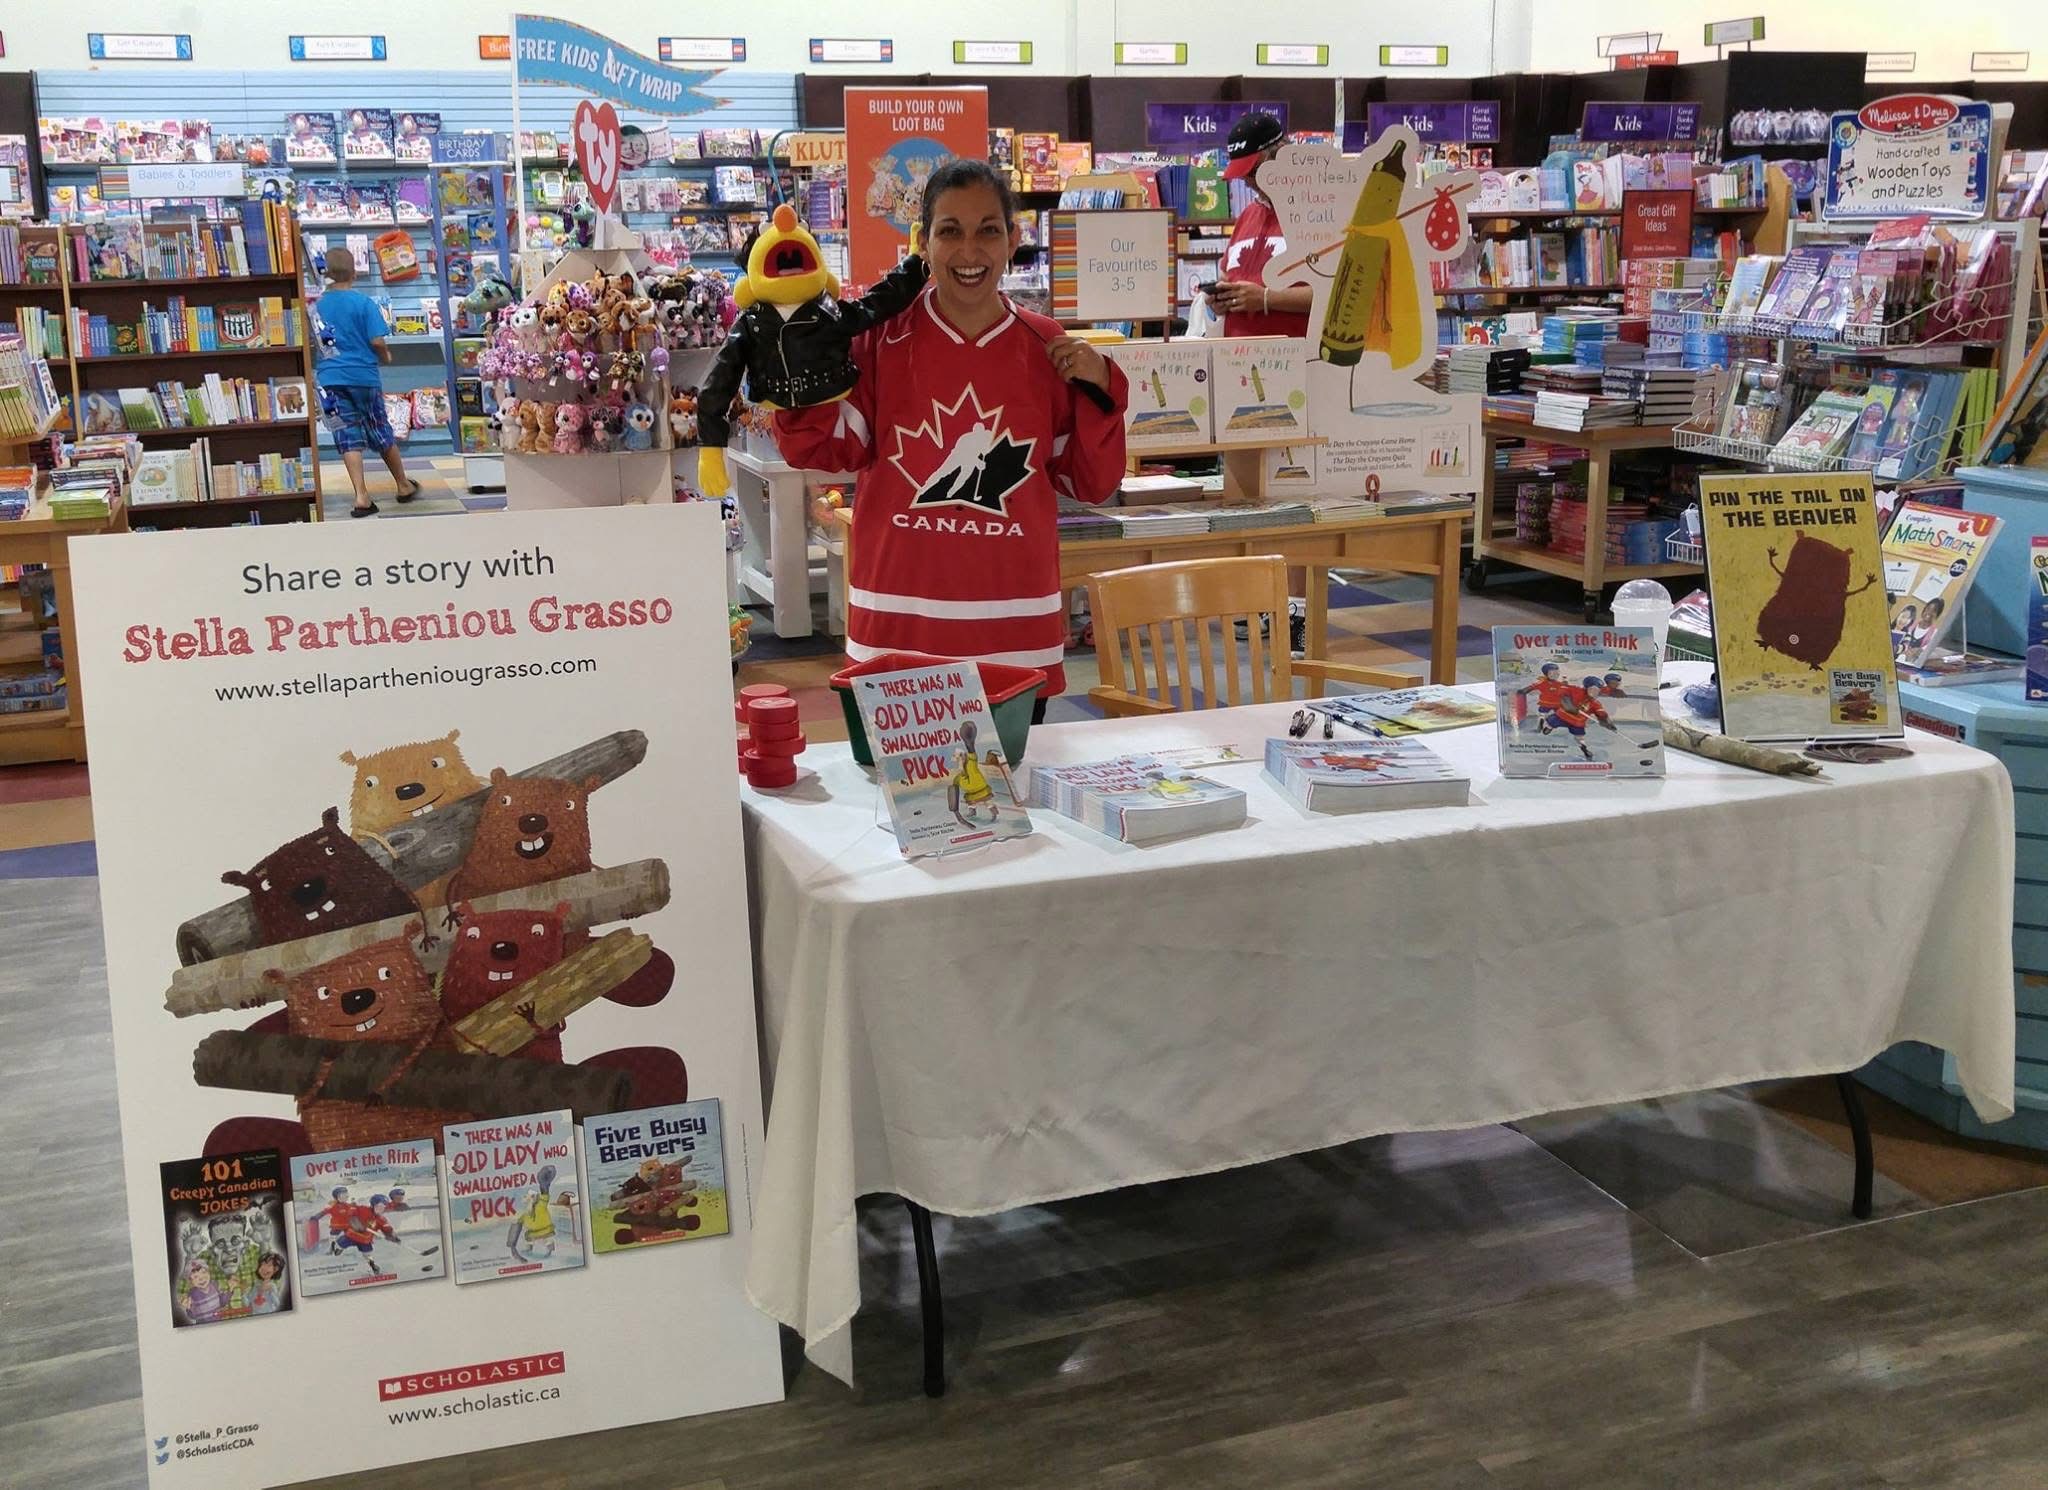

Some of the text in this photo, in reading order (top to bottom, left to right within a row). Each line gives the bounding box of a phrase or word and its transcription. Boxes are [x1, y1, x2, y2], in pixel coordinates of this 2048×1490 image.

[517, 37, 556, 63] FREE
[561, 41, 600, 73] KIDS
[639, 71, 683, 103] WRAP
[868, 99, 964, 115] BUILD YOUR OWN
[1473, 106, 1490, 114] Great
[1678, 107, 1694, 116] Great
[1868, 108, 1912, 126] Melissa
[1922, 103, 1951, 125] Doug
[892, 117, 945, 132] LOOT BAG
[1183, 115, 1217, 133] Kids
[1402, 114, 1434, 132] Kids
[1472, 123, 1489, 132] Great
[1613, 114, 1642, 131] Kids
[438, 138, 487, 150] BIRTHDAY
[446, 148, 480, 158] CARDS
[795, 140, 846, 162] KLUT
[1291, 152, 1332, 167] Every
[138, 167, 233, 180] Babies & Toddlers
[1265, 173, 1313, 188] Crayon
[1867, 162, 1952, 182] Wooden Toys
[1301, 191, 1336, 205] Place
[1872, 184, 1943, 200] and Puzzles
[1306, 210, 1335, 224] Call
[1637, 204, 1676, 218] Great Gift
[1645, 219, 1668, 233] Ideas
[1110, 237, 1136, 253] Our
[1088, 257, 1159, 273] Favourites
[1111, 276, 1136, 292] 3-5
[1708, 487, 1867, 507] PIN THE TAIL ON
[891, 513, 1025, 537] CANADA
[1723, 507, 1858, 528] THE BEAVER
[1979, 517, 1988, 532] 1
[1892, 523, 1976, 557] MathSmart
[241, 545, 555, 594] Share a story with
[122, 594, 673, 664] Stella Partheniou Grasso
[1513, 631, 1639, 651] Over at the Rink
[214, 657, 597, 702] www.stellapartheniougrasso.com
[878, 672, 964, 699] THERE WAS AN
[1832, 671, 1882, 683] Five Busy
[1834, 679, 1877, 689] Beavers
[874, 693, 984, 731] OLD LADY WHO
[1905, 711, 1958, 738] Canadian
[880, 729, 961, 756] SWALLOWED A
[901, 754, 950, 786] PUCK
[1054, 771, 1087, 782] OLD
[1091, 767, 1135, 779] LADY
[1096, 783, 1146, 794] PUCK
[464, 1120, 553, 1146] THERE WAS AN
[594, 1116, 707, 1147] Five Busy
[452, 1140, 568, 1175] OLD LADY WHO
[599, 1136, 696, 1164] Beavers
[201, 1157, 244, 1182] 101
[305, 1148, 420, 1178] Over at the Rink
[170, 1177, 277, 1202] Creepy Canadian
[453, 1172, 537, 1197] SWALLOWED A
[199, 1196, 250, 1216] JOKES
[469, 1196, 517, 1223] PUCK
[406, 1356, 561, 1392] SCHOLASTIC
[388, 1387, 561, 1426] www.scholastic.ca
[175, 1422, 259, 1445] @Stella_P_Grasso
[176, 1438, 255, 1461] @ScholasticCDA
